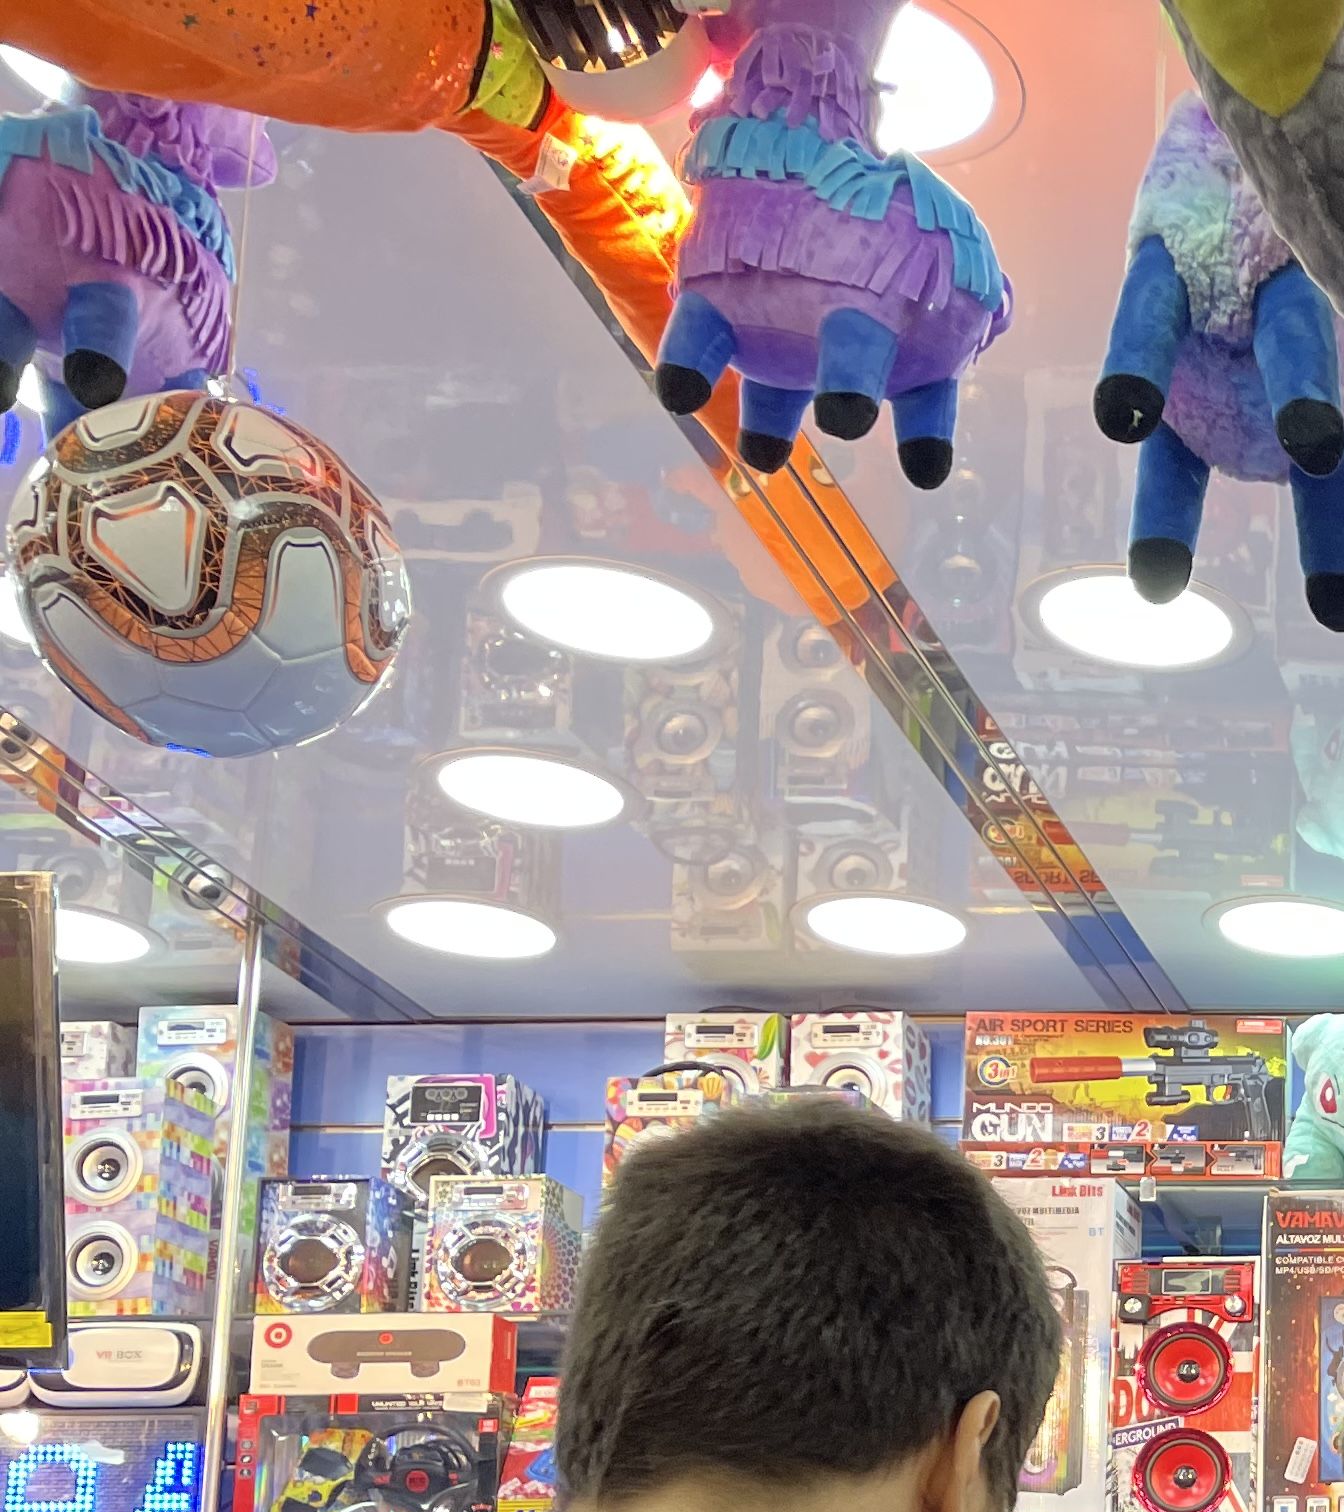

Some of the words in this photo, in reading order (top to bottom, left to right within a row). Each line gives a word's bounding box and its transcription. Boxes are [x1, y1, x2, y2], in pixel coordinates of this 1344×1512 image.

[975, 1019, 1004, 1033] AIR
[1010, 1019, 1068, 1034] SPORT
[1074, 1020, 1133, 1034] SERIES
[972, 1102, 1053, 1113] MUNDO
[971, 1114, 1053, 1142] GUN
[1136, 1121, 1149, 1138] 2
[1276, 1233, 1322, 1245] ALTAVOZ
[1275, 1255, 1335, 1265] COMPATIBLE
[116, 1350, 143, 1360] BOX
